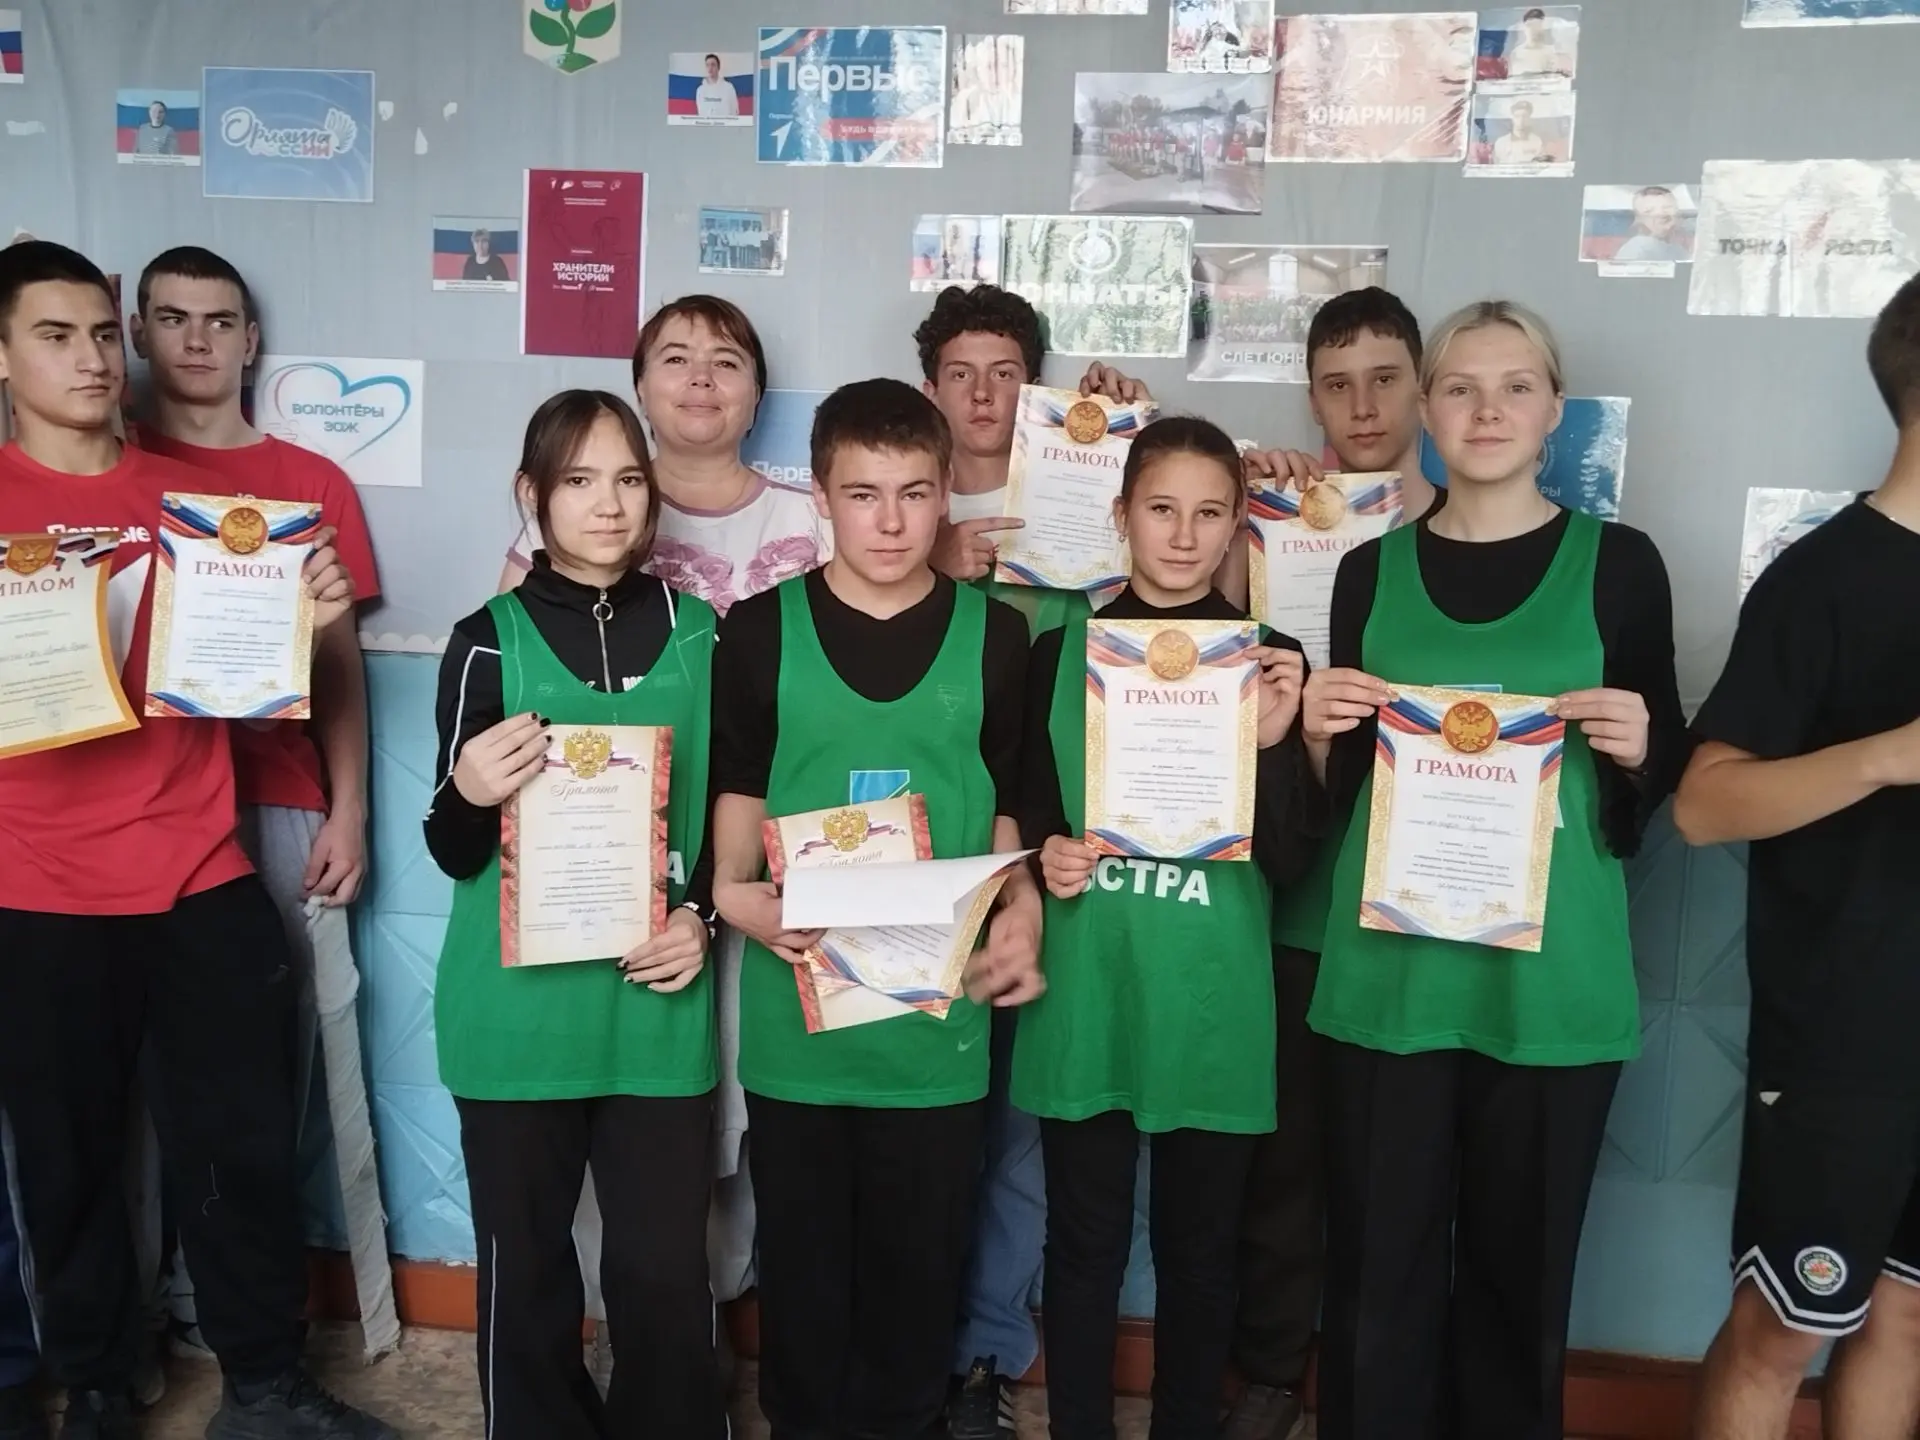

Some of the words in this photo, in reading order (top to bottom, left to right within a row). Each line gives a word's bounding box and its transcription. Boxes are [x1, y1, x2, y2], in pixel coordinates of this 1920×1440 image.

[769, 56, 930, 103] Первые
[1305, 104, 1426, 126] ЮНАРМИЯ
[1718, 238, 1787, 255] ТОЧКА
[1824, 239, 1894, 255] РОСТА
[552, 261, 615, 274] ХРАНИТЕЛИ
[557, 271, 610, 282] ИСТОРИИ
[291, 403, 385, 418] ВОЛОНТЁРЫ
[323, 421, 360, 433] ЗОЖ
[1042, 446, 1121, 469] ГРАМОТА
[1281, 537, 1365, 554] ГРАМОТ
[193, 560, 286, 580] ГРАМОТА
[1123, 689, 1220, 705] ГРАМОТА
[1413, 758, 1519, 784] ГРАМОТА
[550, 778, 620, 801] Грамота
[1083, 856, 1211, 906] СТРА
